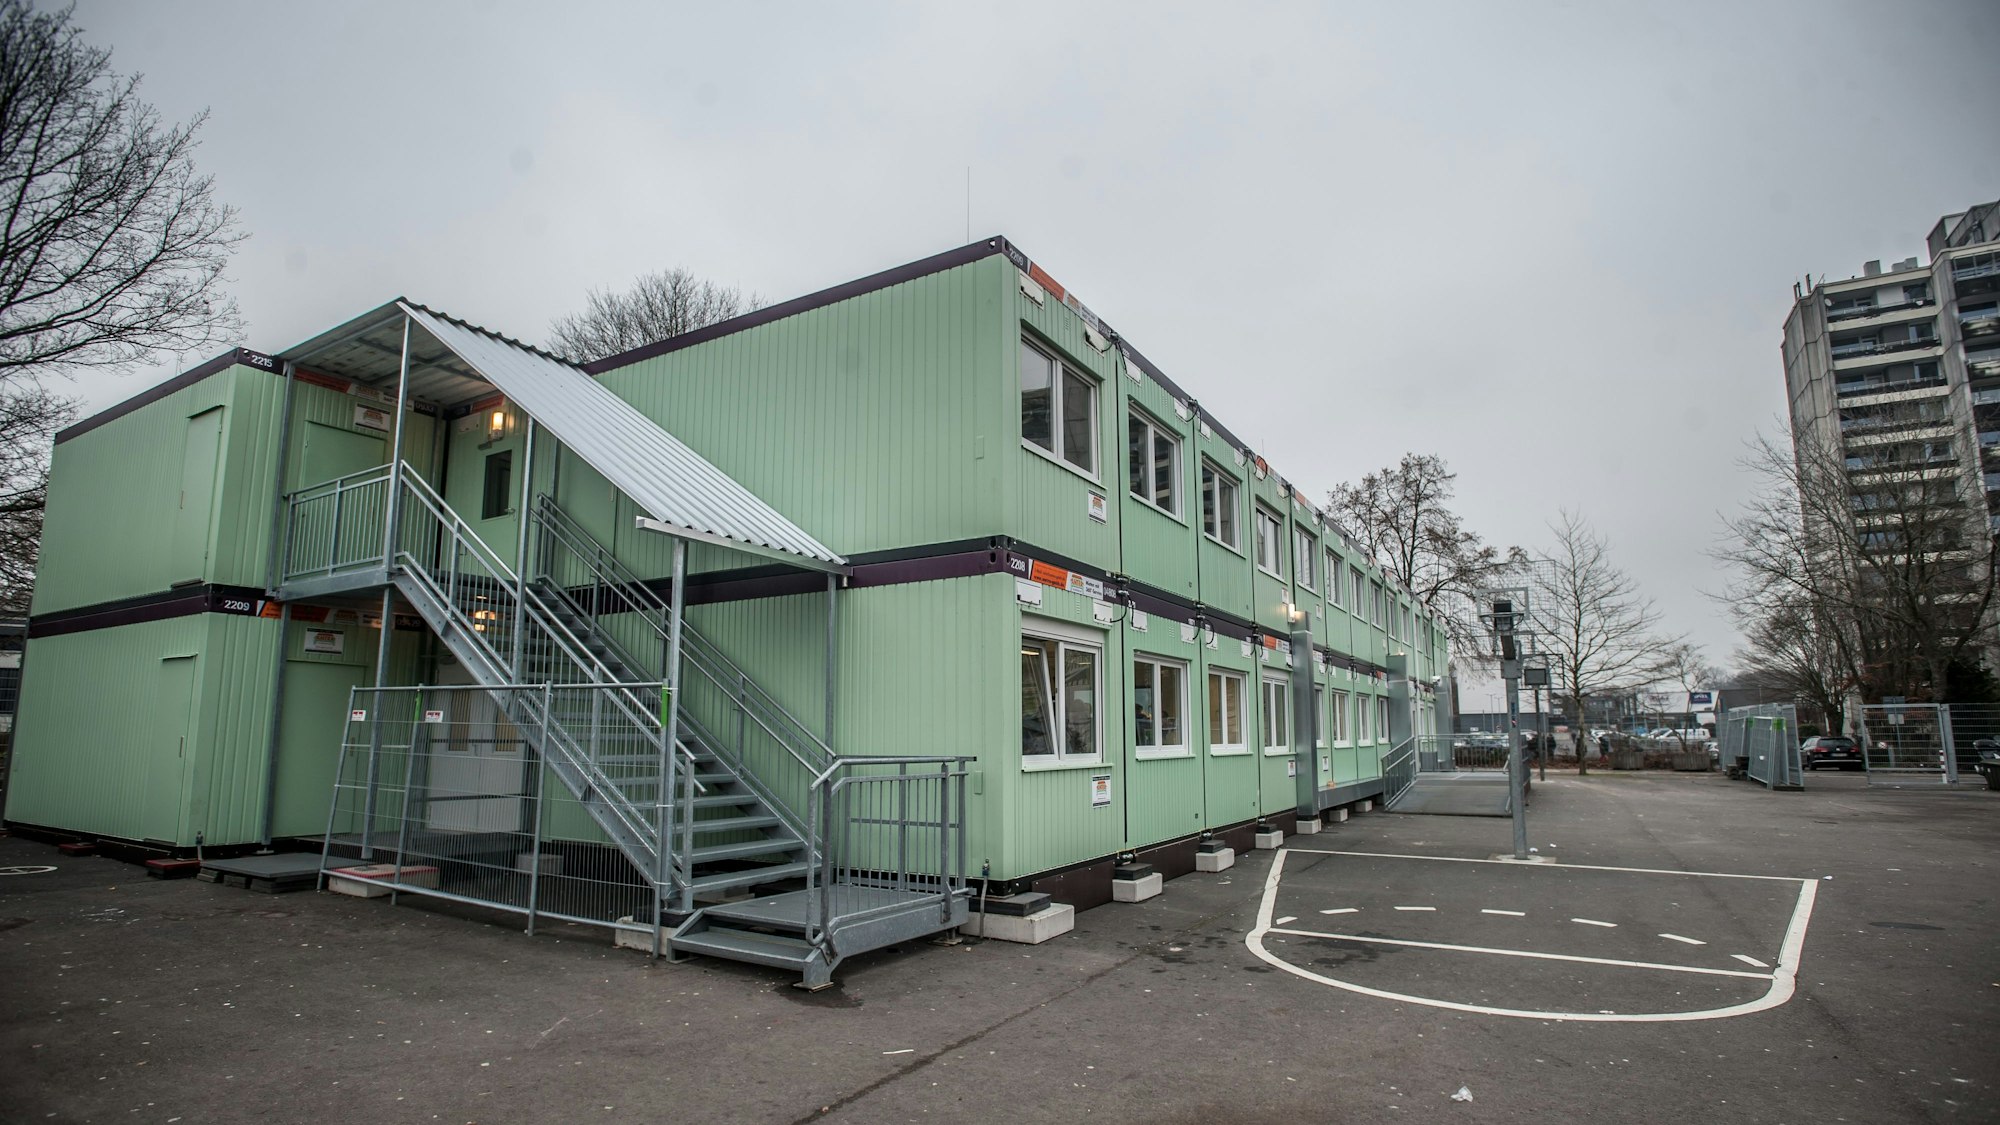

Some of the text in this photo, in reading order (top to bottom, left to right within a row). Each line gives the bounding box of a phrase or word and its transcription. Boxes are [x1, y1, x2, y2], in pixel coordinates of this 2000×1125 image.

[251, 354, 272, 368] 2215
[1010, 557, 1025, 572] 2208
[224, 599, 250, 612] 2209
